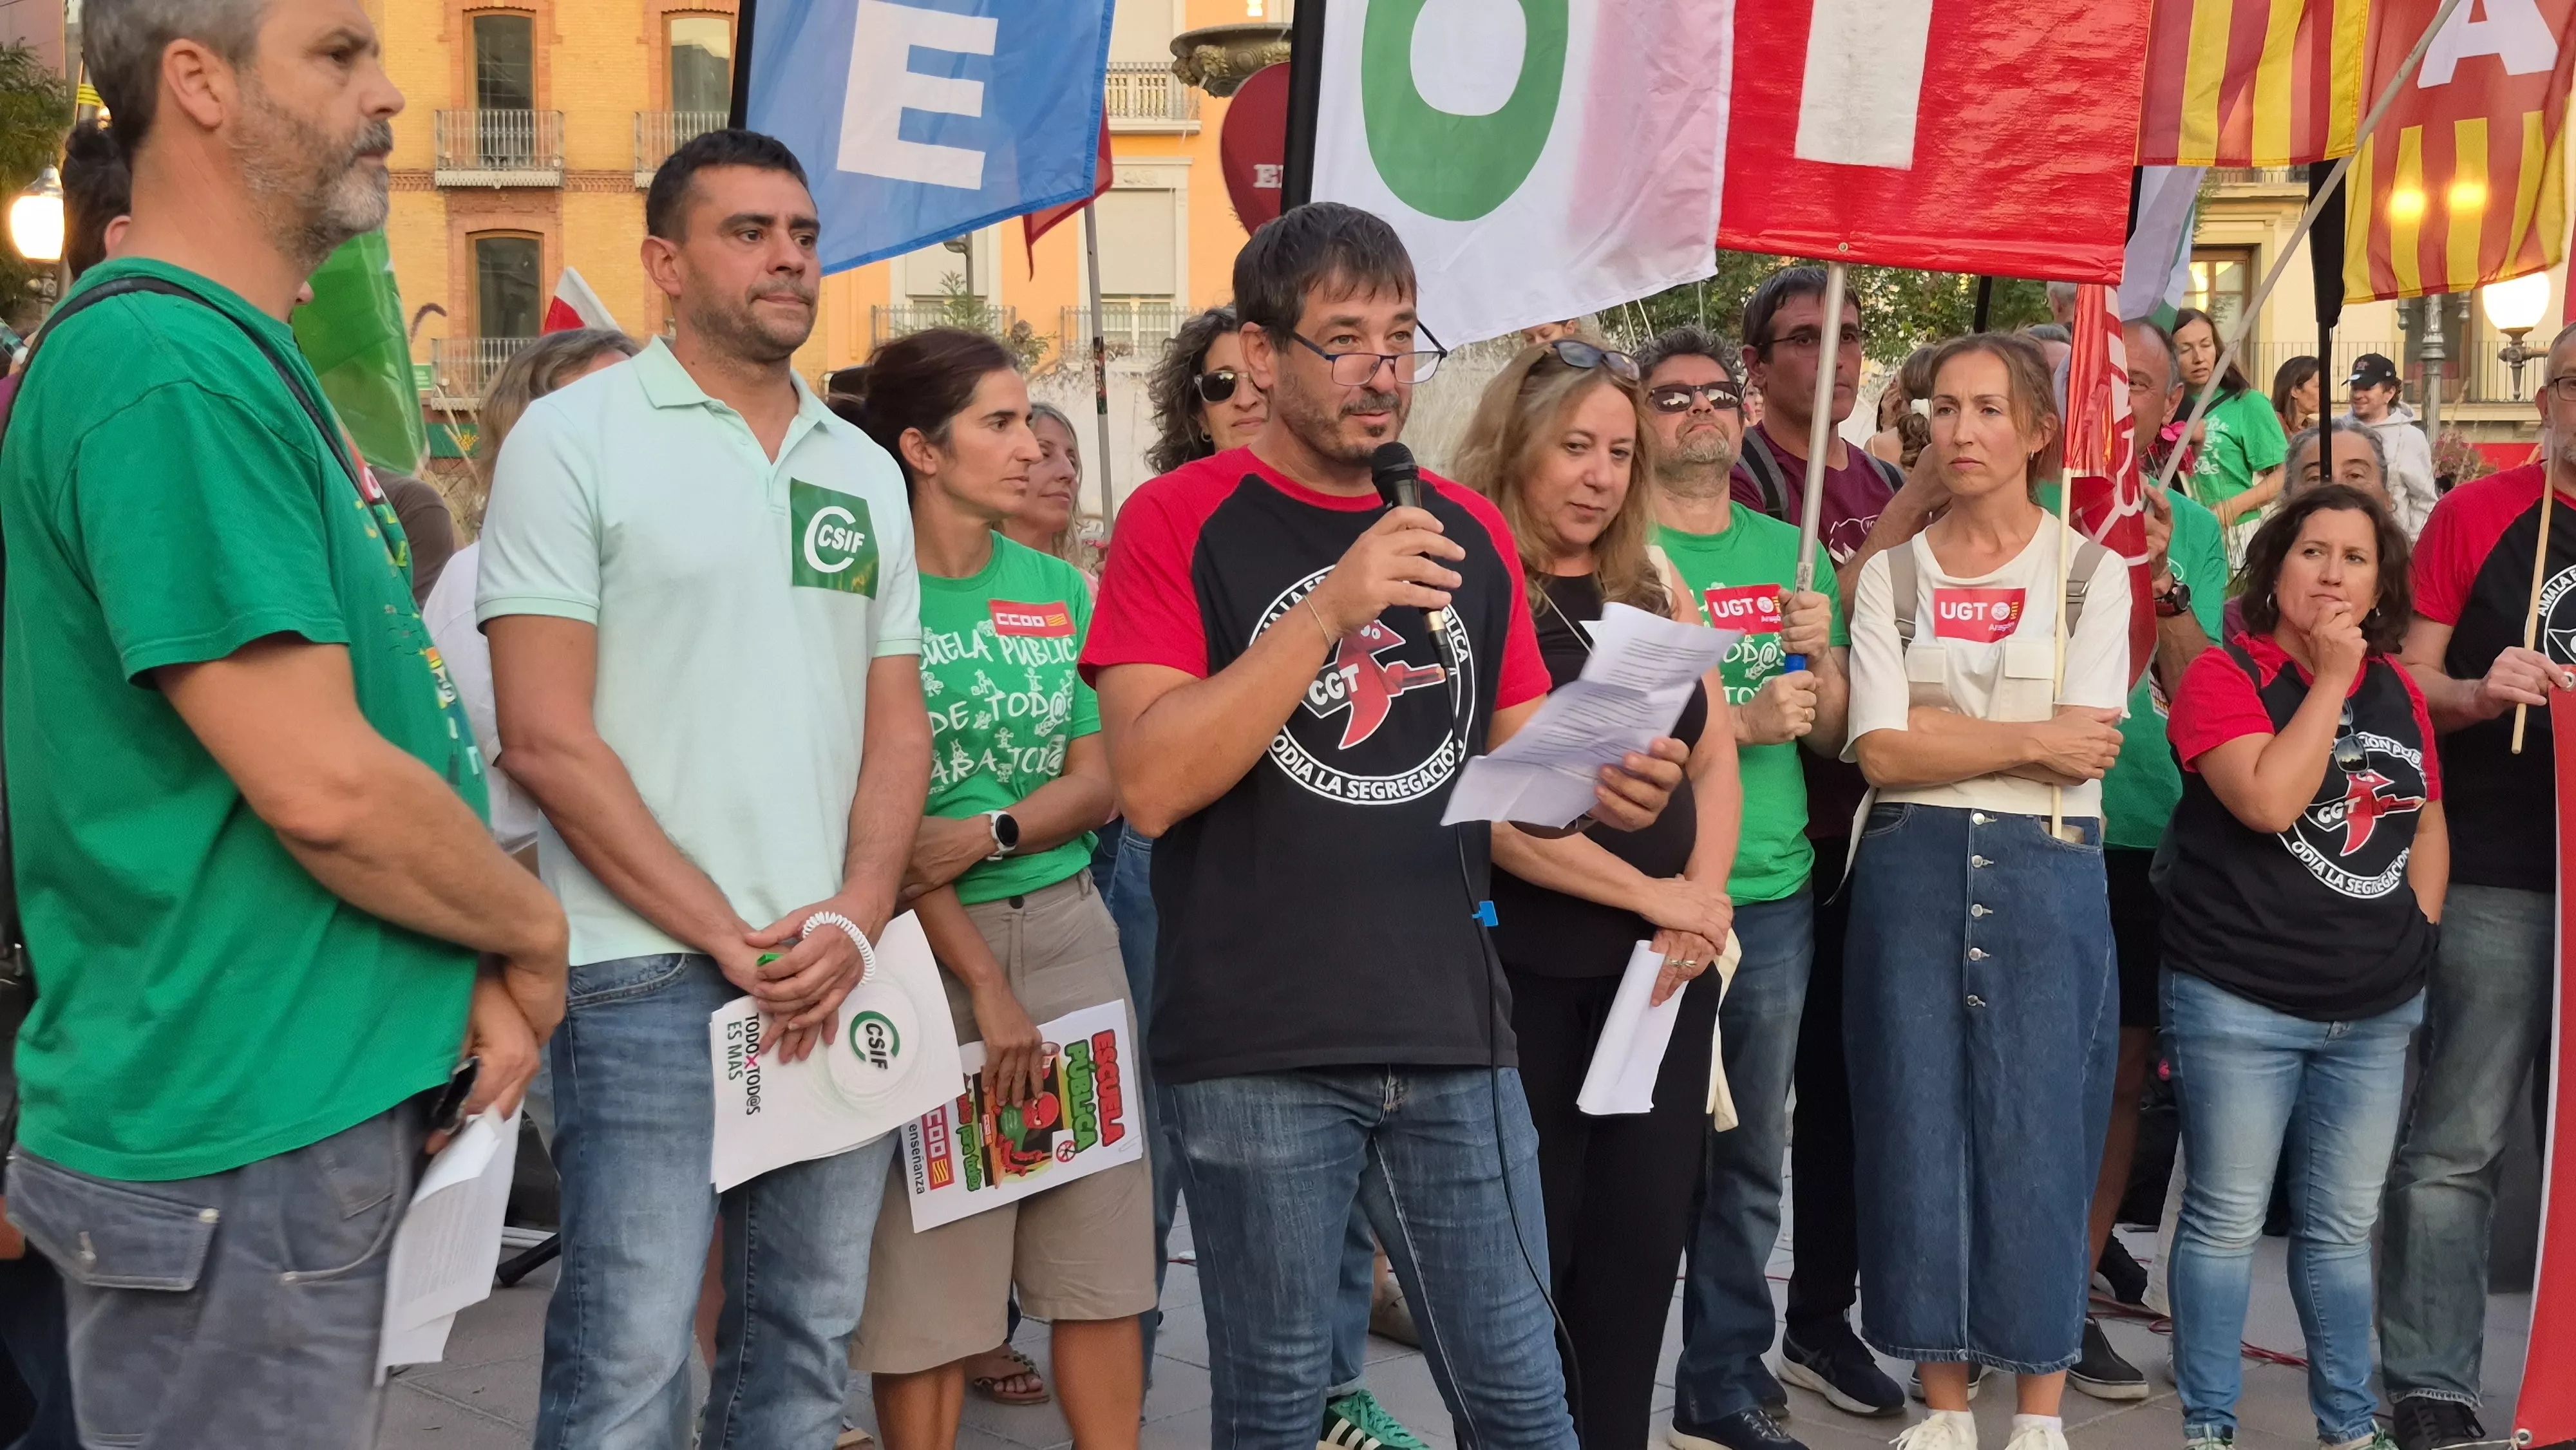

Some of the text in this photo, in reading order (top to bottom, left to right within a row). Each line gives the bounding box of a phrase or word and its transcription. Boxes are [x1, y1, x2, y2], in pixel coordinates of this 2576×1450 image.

[837, 0, 998, 190] E
[1253, 164, 1283, 189] E
[817, 523, 866, 554] CSIF
[995, 612, 1046, 627] CCOO
[1712, 597, 1754, 618] UGT
[1940, 601, 1988, 621] UGT
[1308, 663, 1359, 706] CGT
[1722, 686, 1756, 706] TO
[927, 701, 969, 737] DE
[1270, 734, 1315, 784] ODIA
[1314, 770, 1342, 796] LA
[2317, 796, 2362, 824] CGT
[2291, 840, 2324, 877] ODIA
[2324, 870, 2345, 889] LA
[727, 1021, 743, 1040] ES
[866, 1022, 888, 1070] CSIF
[1091, 1028, 1126, 1147] ESCUELA
[908, 1123, 925, 1195] enseñanza
